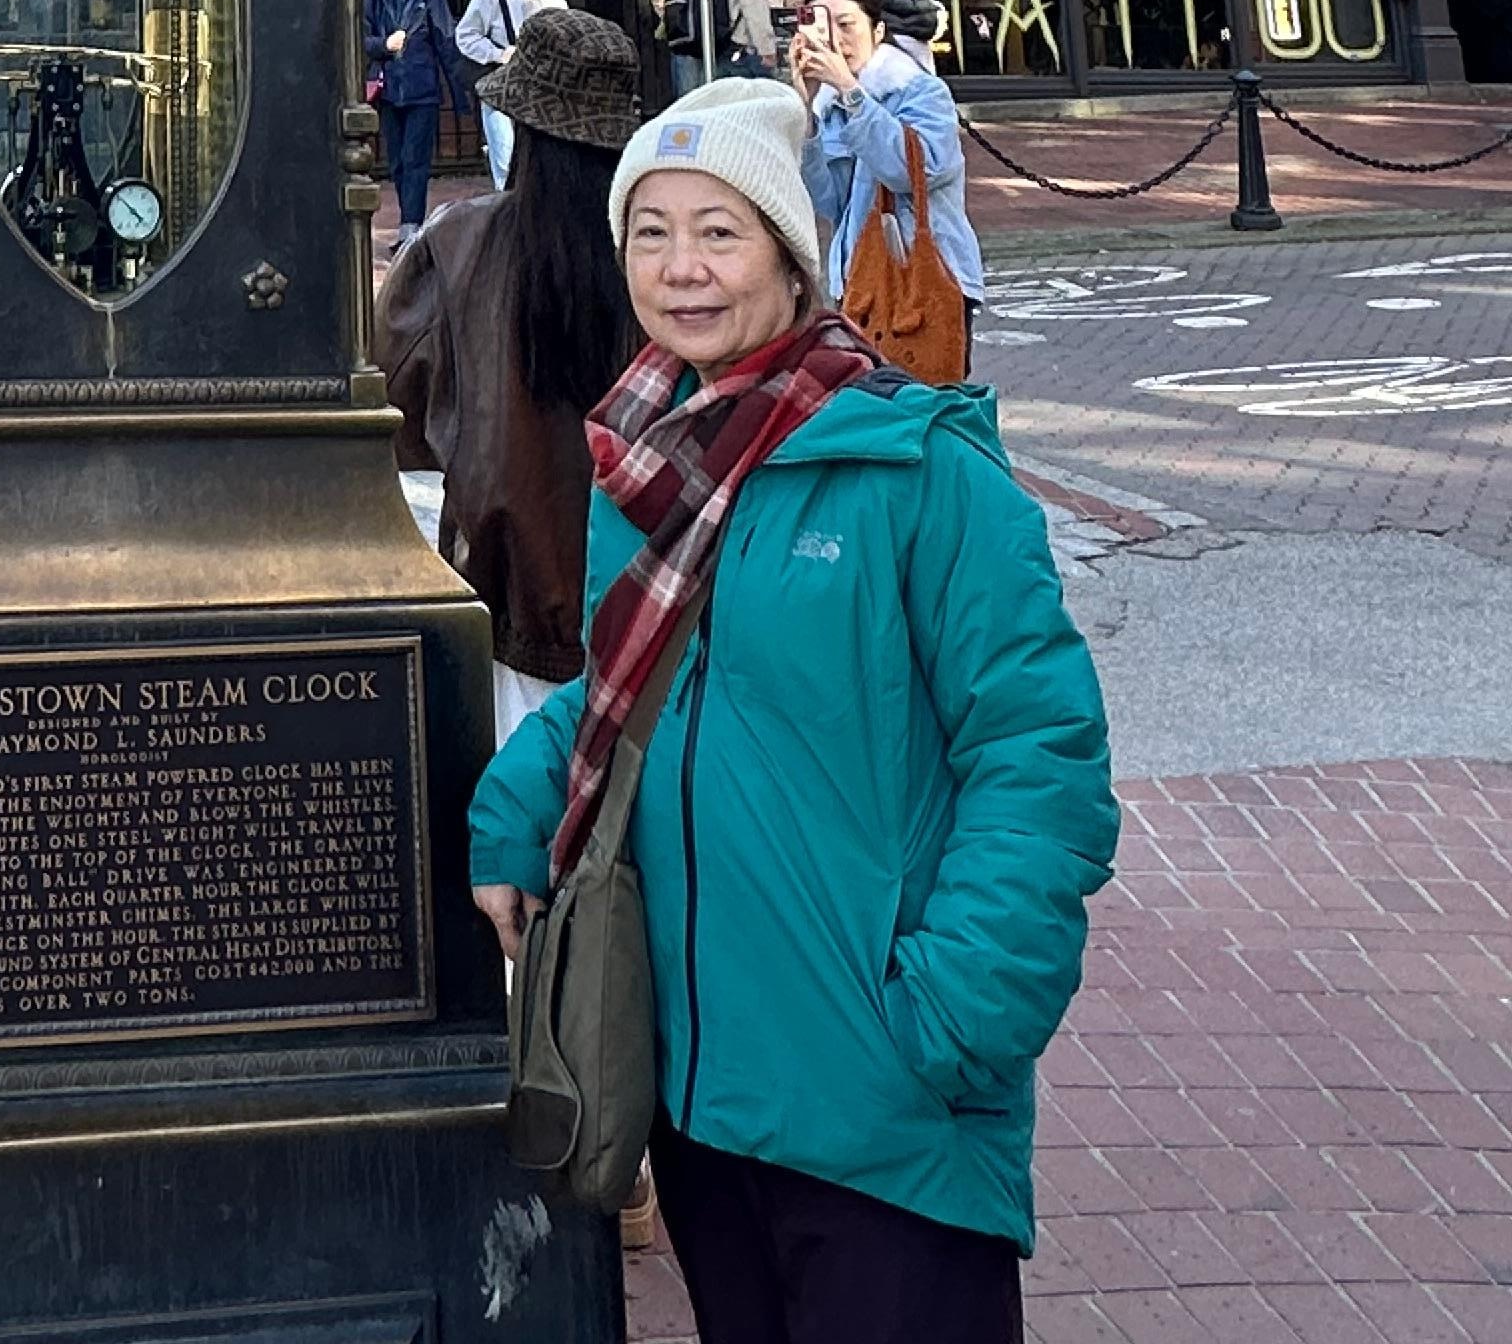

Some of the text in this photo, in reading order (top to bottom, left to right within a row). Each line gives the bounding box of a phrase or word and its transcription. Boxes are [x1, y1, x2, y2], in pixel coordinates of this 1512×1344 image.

[140, 677, 247, 709] STEAM
[263, 671, 379, 704] CLOCK
[117, 731, 136, 748] L.
[148, 724, 266, 747] SAUNDERS
[24, 775, 73, 792] FIRST
[81, 771, 137, 789] STEAM
[147, 767, 233, 785] POWERED
[242, 764, 301, 780] CLOCK
[311, 762, 342, 777] HAS
[351, 759, 393, 774] BEEN
[40, 791, 150, 811] ENJOYMENT
[161, 790, 183, 805] OF
[193, 784, 297, 802] EVERYONE.
[311, 782, 343, 797] THE
[354, 779, 393, 794] LIVE
[0, 816, 35, 831] THE
[47, 812, 130, 828] WEIGHTS
[139, 809, 179, 824] AND
[190, 804, 252, 822] BLOWS
[260, 803, 294, 817] THE
[49, 833, 87, 849] ONE
[98, 829, 151, 846] STEEL
[161, 825, 236, 842] WEIGHT
[245, 821, 289, 838] WILL
[297, 817, 365, 835] TRAVEL
[372, 816, 395, 831] BY
[0, 856, 21, 871] TO
[29, 853, 63, 868] THE
[73, 851, 107, 867] TOP
[115, 850, 136, 865] OF
[147, 848, 183, 862] THE
[268, 840, 304, 855] THE
[315, 834, 397, 853] GRAVITY
[107, 866, 168, 885] DRIVE
[184, 864, 225, 880] WAS
[375, 854, 395, 869] BY
[48, 892, 95, 908] EACH
[102, 887, 184, 908] QUARTER
[192, 883, 242, 899] HOUR
[247, 881, 280, 895] THE
[288, 877, 348, 893] CLOCK
[355, 873, 399, 889] WILL
[208, 904, 242, 919] THE
[251, 899, 308, 916] LARGE
[321, 893, 400, 910] WHISTLE
[38, 933, 63, 948] ON
[72, 931, 104, 947] THE
[171, 925, 205, 941] THE
[212, 921, 265, 939] STEAM
[272, 919, 286, 935] IS
[292, 915, 371, 934] SUPPLIED
[379, 913, 400, 928] BY
[40, 952, 103, 970] SYSTEM
[109, 951, 131, 966] OF
[137, 945, 219, 963] CENTRAL
[227, 940, 271, 959] HEAT
[276, 933, 402, 955] DISTRIBUTORS
[0, 970, 113, 992] COMPONENT
[129, 967, 182, 984] PARTS
[195, 963, 242, 980] COST
[322, 956, 361, 973] AND
[371, 954, 403, 969] THE
[19, 994, 71, 1011] OVER
[83, 991, 127, 1007] TWO
[139, 986, 195, 1004] TONS.
